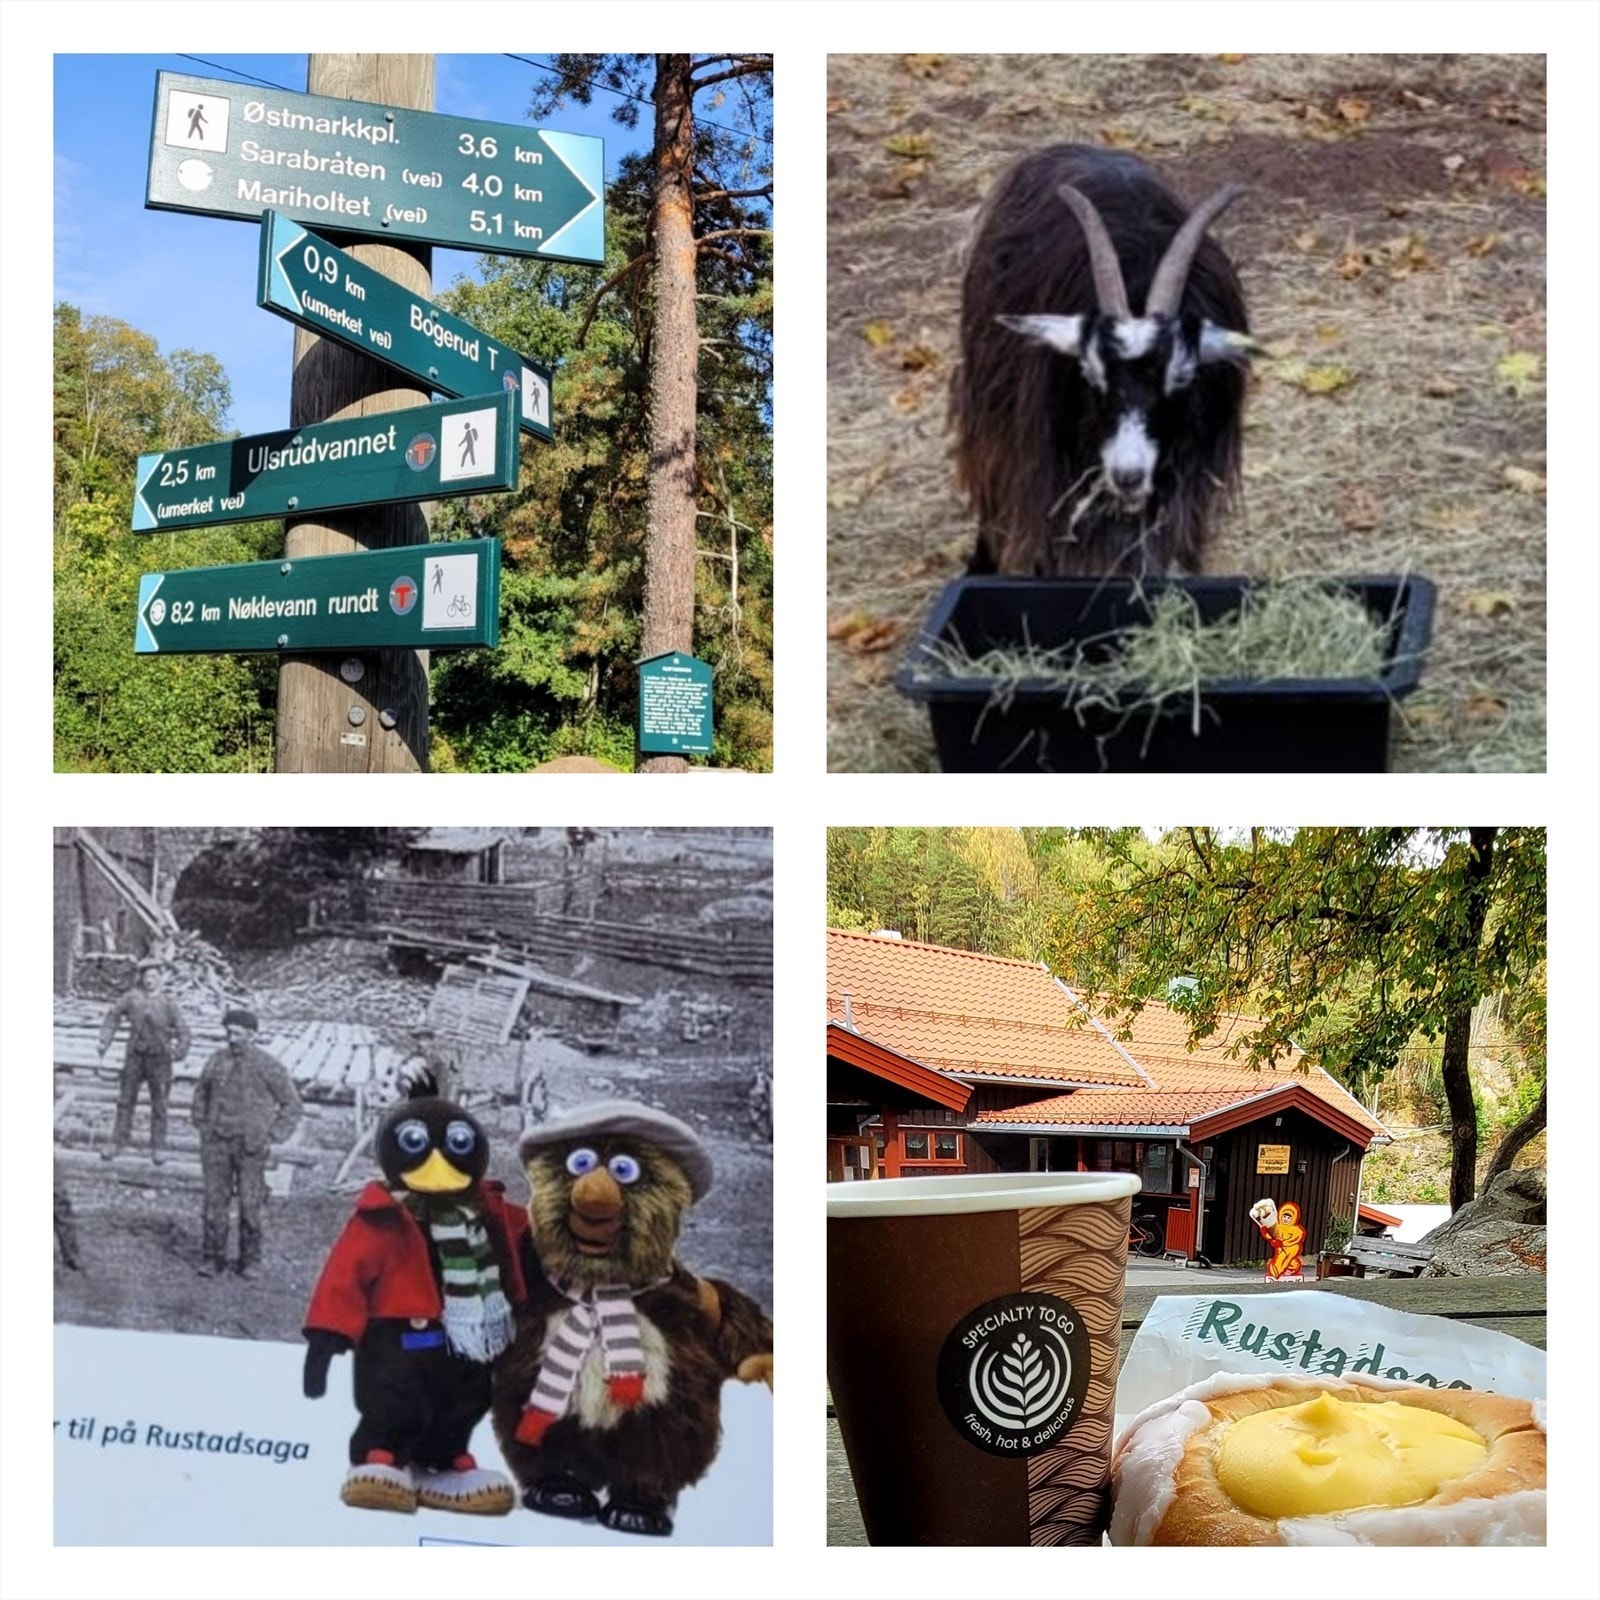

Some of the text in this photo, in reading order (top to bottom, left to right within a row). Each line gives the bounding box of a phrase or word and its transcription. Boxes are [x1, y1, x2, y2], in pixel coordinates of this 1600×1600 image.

[243, 101, 543, 165] Østmarkkpl. 3,6 km
[241, 141, 543, 203] Sarabråten (vei) 4,0 km
[237, 180, 543, 240] Mariholtet (vei) 5,1 km
[303, 245, 366, 302] 0,9 km
[301, 289, 392, 350] (umerket vei)
[410, 304, 499, 371] Bogerud T
[160, 459, 215, 487] 2,5 km
[247, 425, 397, 473] Ulsrudvannet
[157, 492, 245, 519] (umerket vei)
[170, 588, 378, 624] 8,2 km Nøklevann rundt
[962, 1306, 1074, 1349] SPECIALTY TO GO
[69, 1417, 96, 1440] til
[101, 1419, 137, 1447] på
[145, 1424, 311, 1464] Rustadsaga
[964, 1397, 1075, 1449] fresh, hot & delicious
